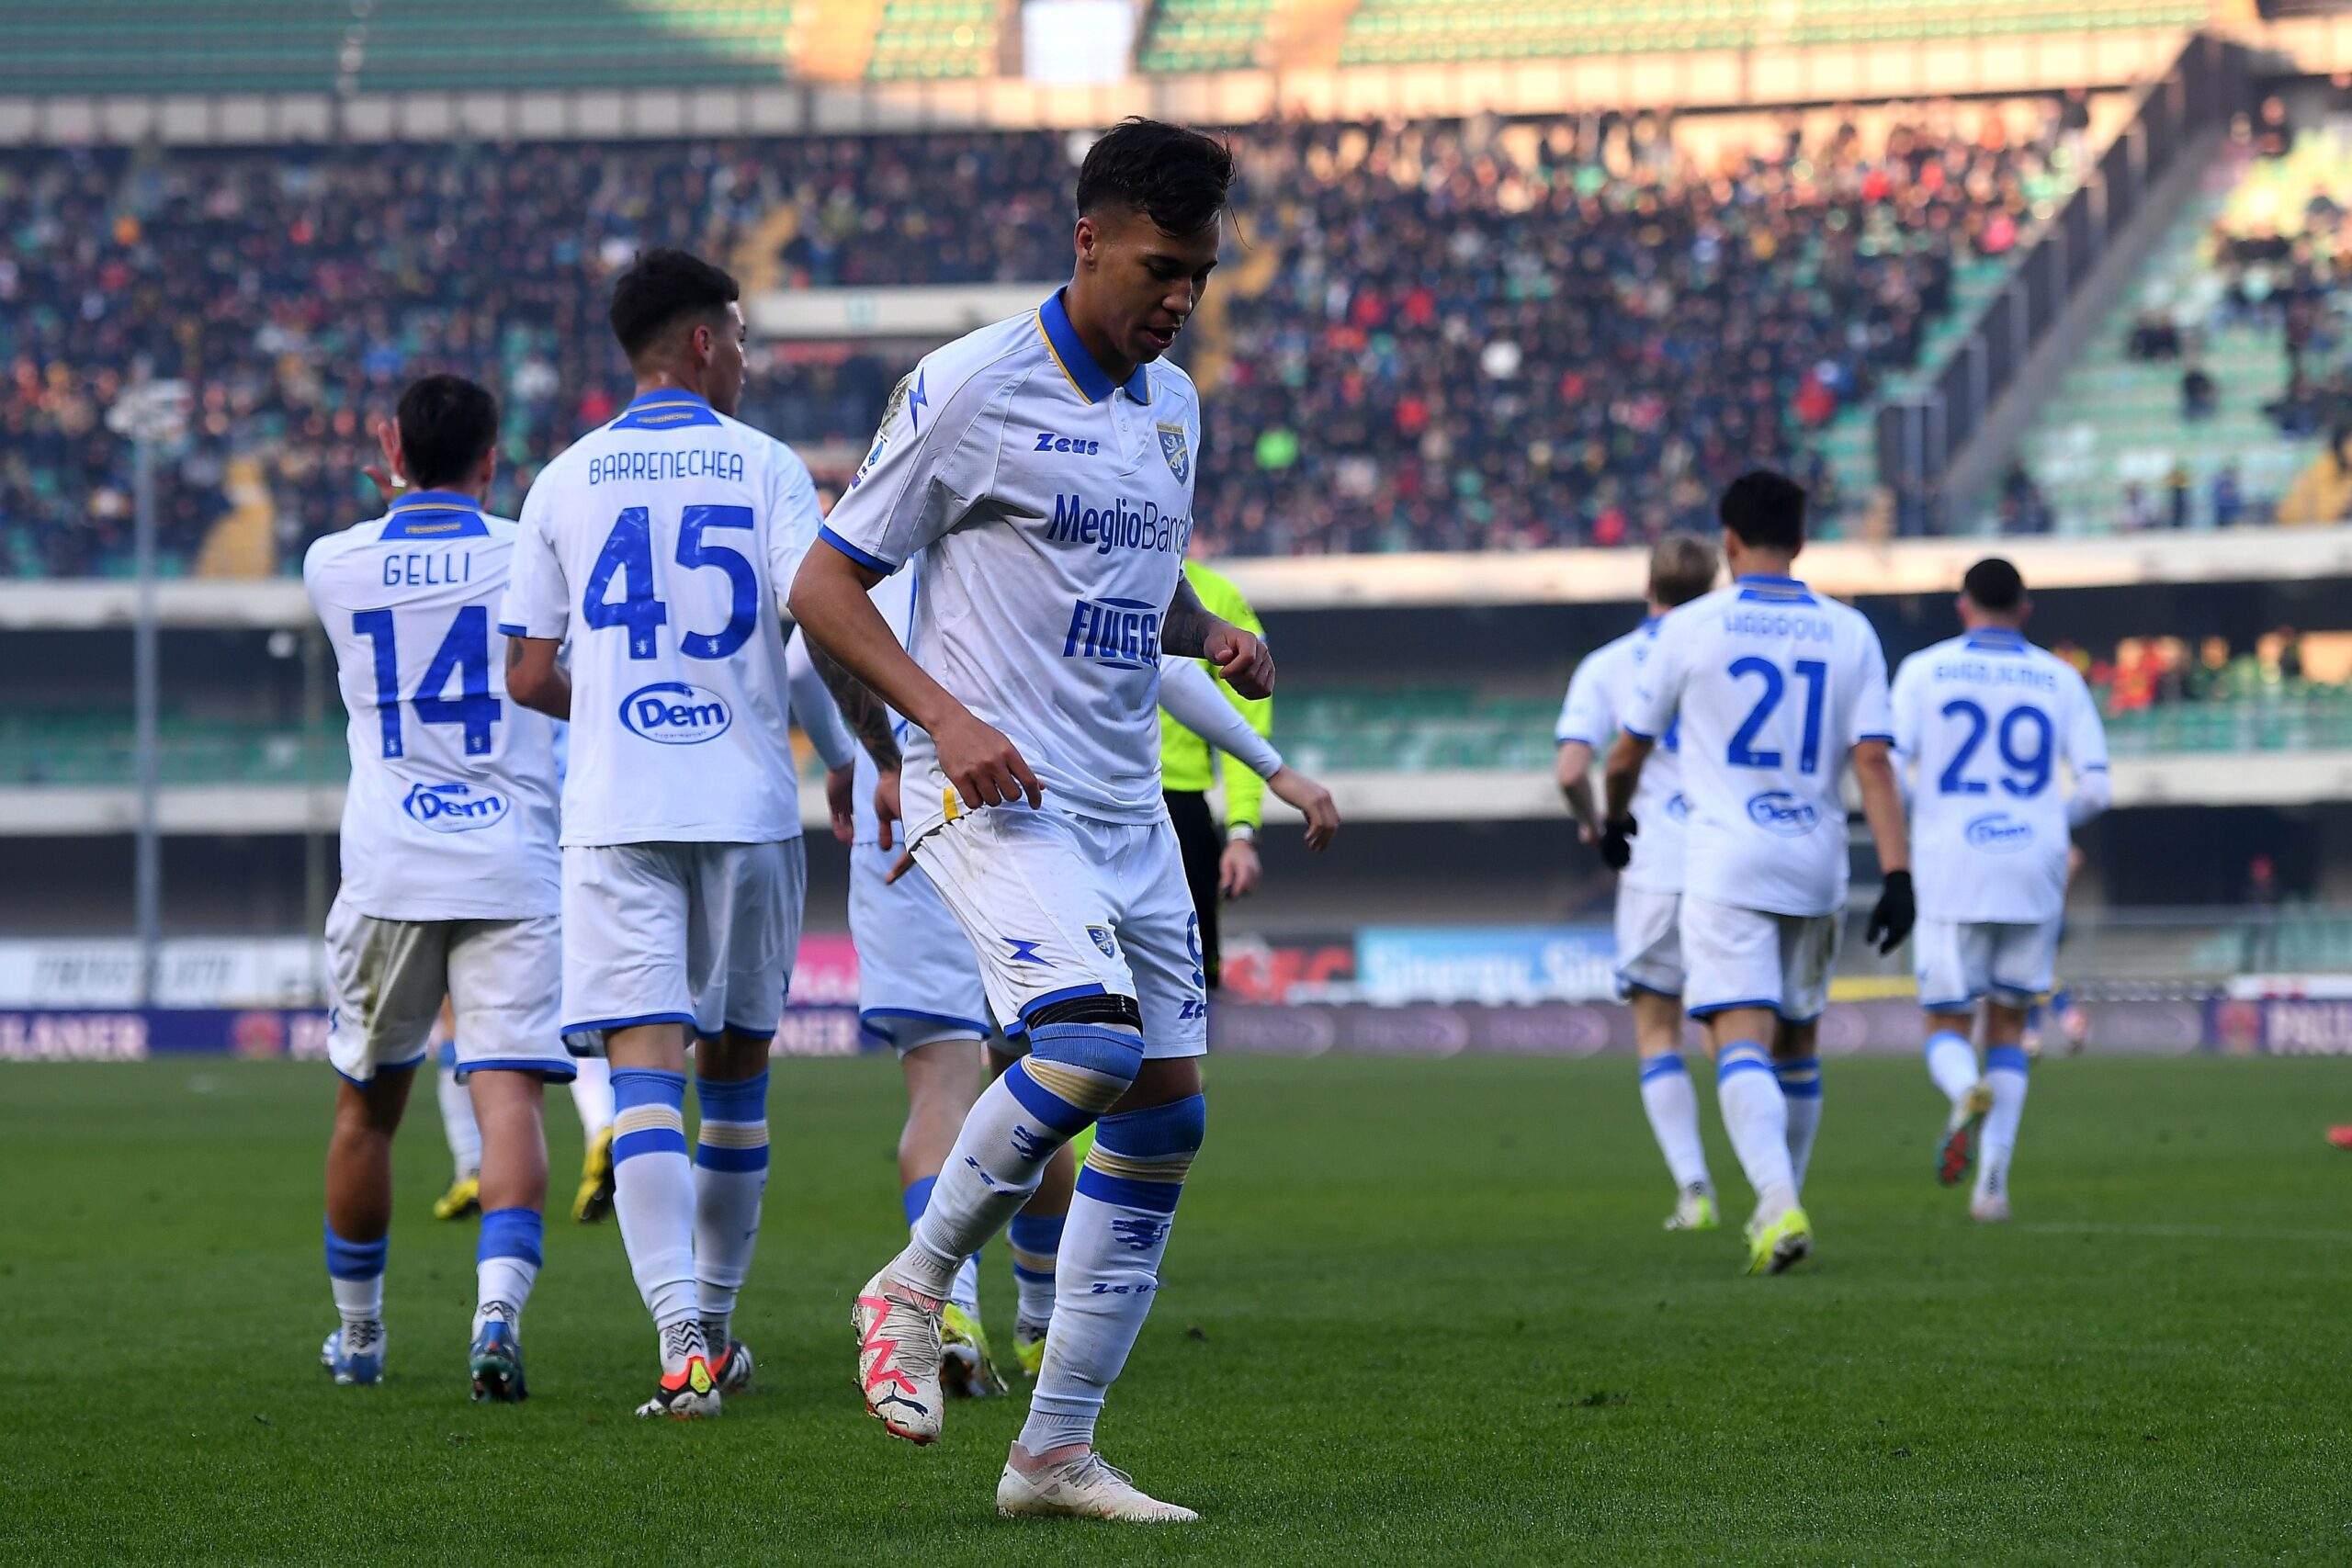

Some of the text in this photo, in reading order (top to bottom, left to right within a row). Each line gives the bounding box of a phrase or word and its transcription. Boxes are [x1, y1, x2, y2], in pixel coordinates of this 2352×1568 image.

[1033, 433, 1100, 456] Zeus
[589, 449, 743, 486] BARRENECHEA
[383, 552, 469, 586] GELLI
[582, 504, 758, 660] 45
[353, 605, 502, 758] 14
[636, 698, 724, 728] Dem
[1727, 657, 1826, 773] 21
[1939, 700, 2053, 796] 29
[418, 793, 501, 818] Dem
